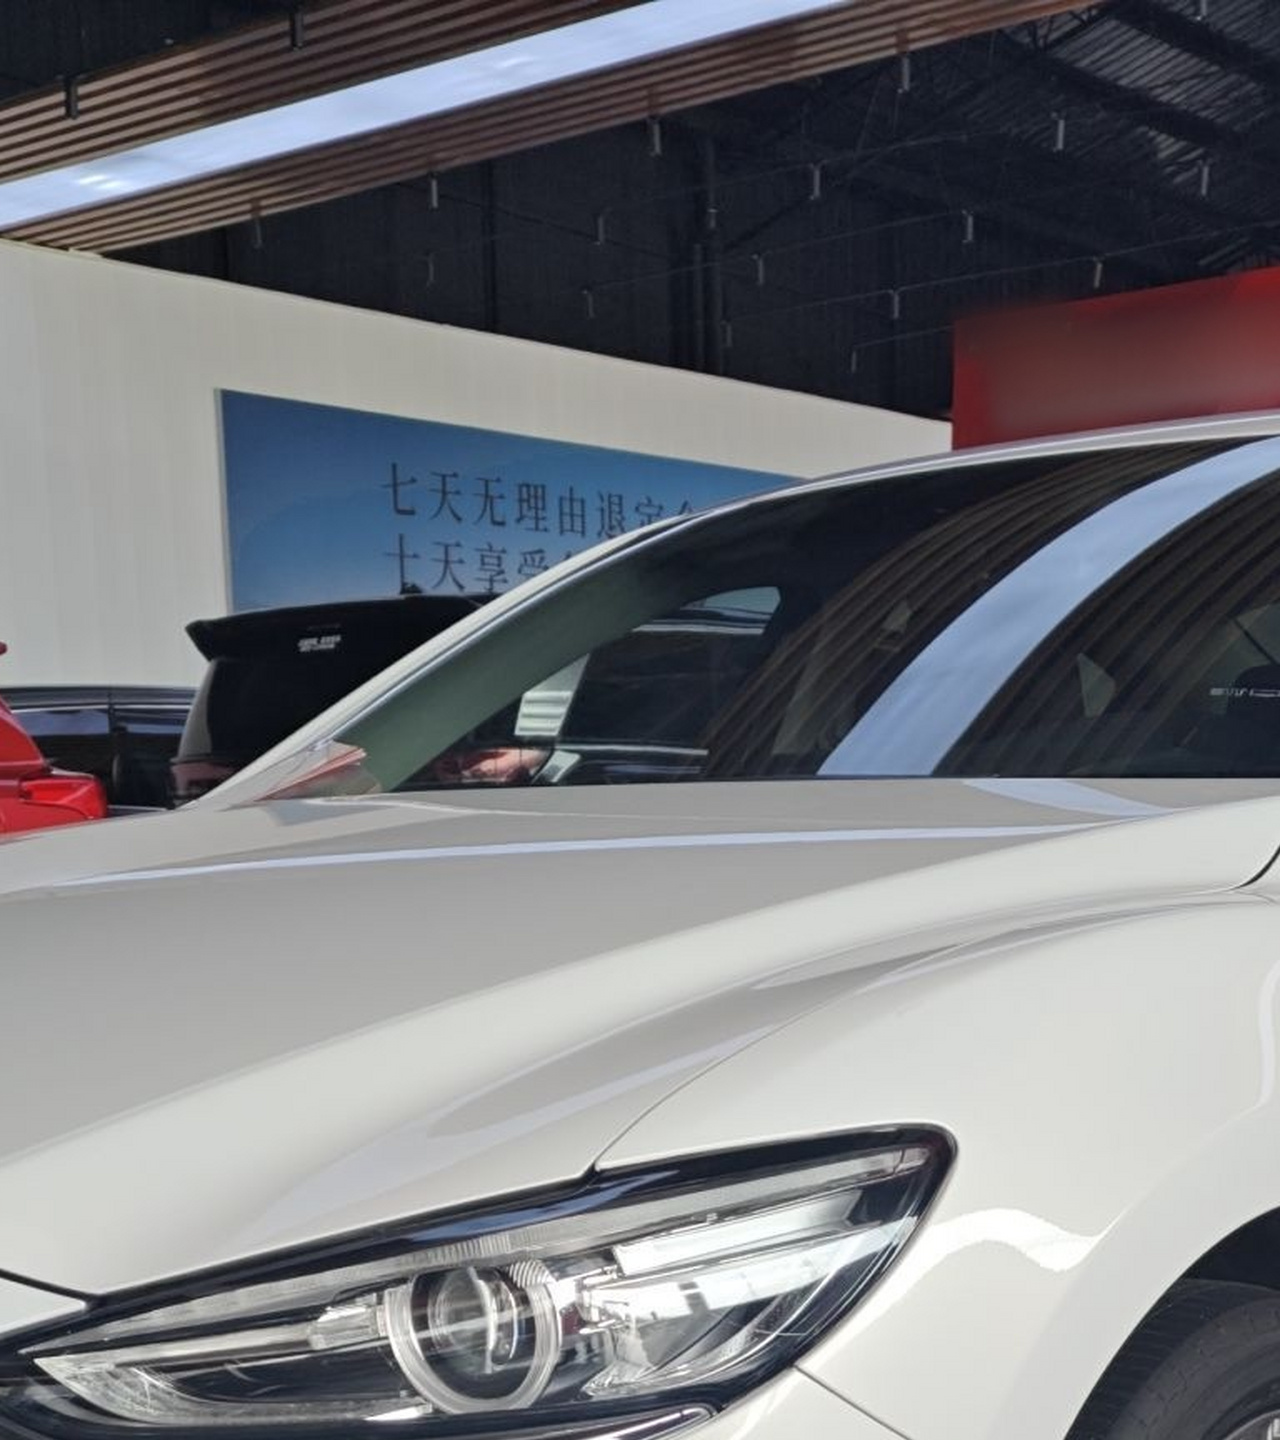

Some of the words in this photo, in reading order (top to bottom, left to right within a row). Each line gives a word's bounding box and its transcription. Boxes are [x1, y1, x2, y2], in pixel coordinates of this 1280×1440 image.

[380, 462, 696, 539] 七天无理由退定
